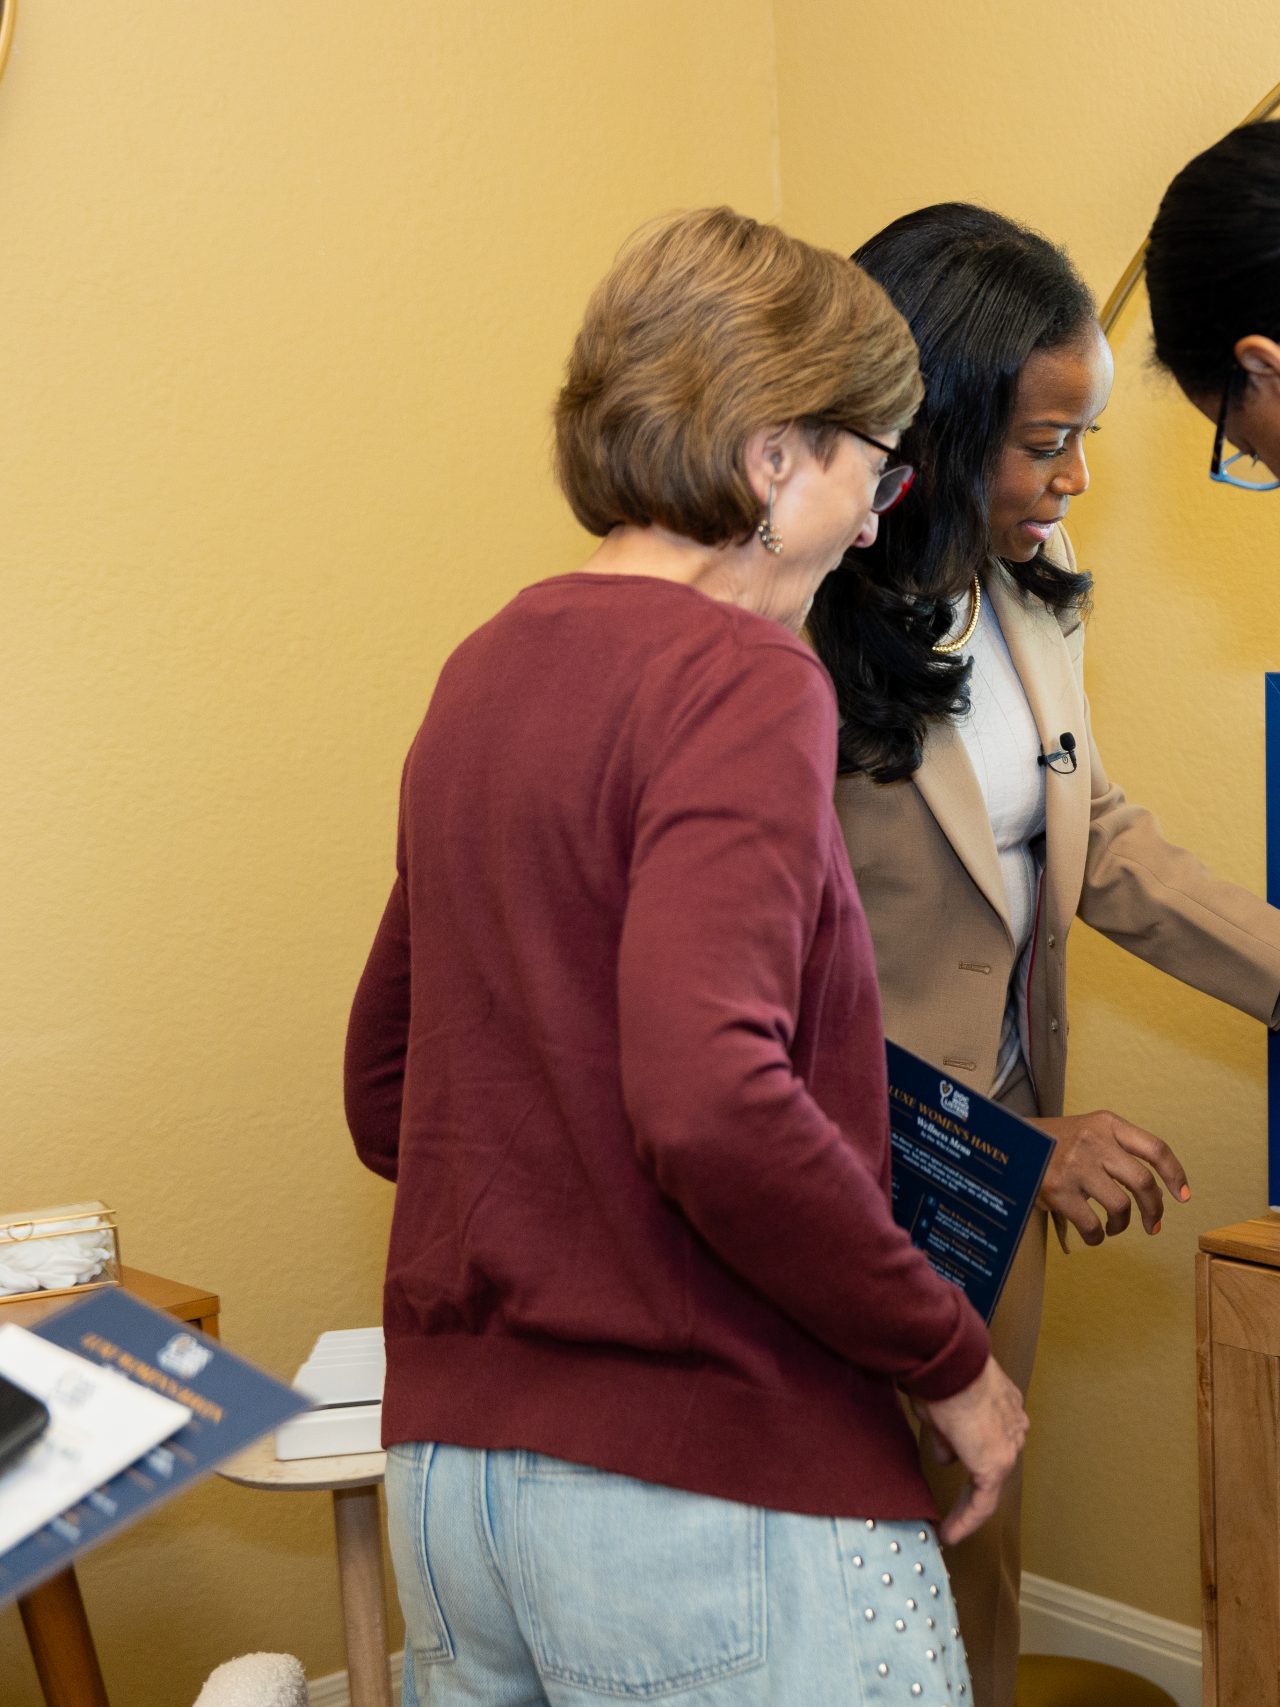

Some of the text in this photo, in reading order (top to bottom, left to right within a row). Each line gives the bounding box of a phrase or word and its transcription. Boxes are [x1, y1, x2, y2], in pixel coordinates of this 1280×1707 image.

[889, 1085, 916, 1107] LUXE
[971, 1136, 1009, 1165] HAVEN
[917, 1116, 970, 1155] Wellness Menu
